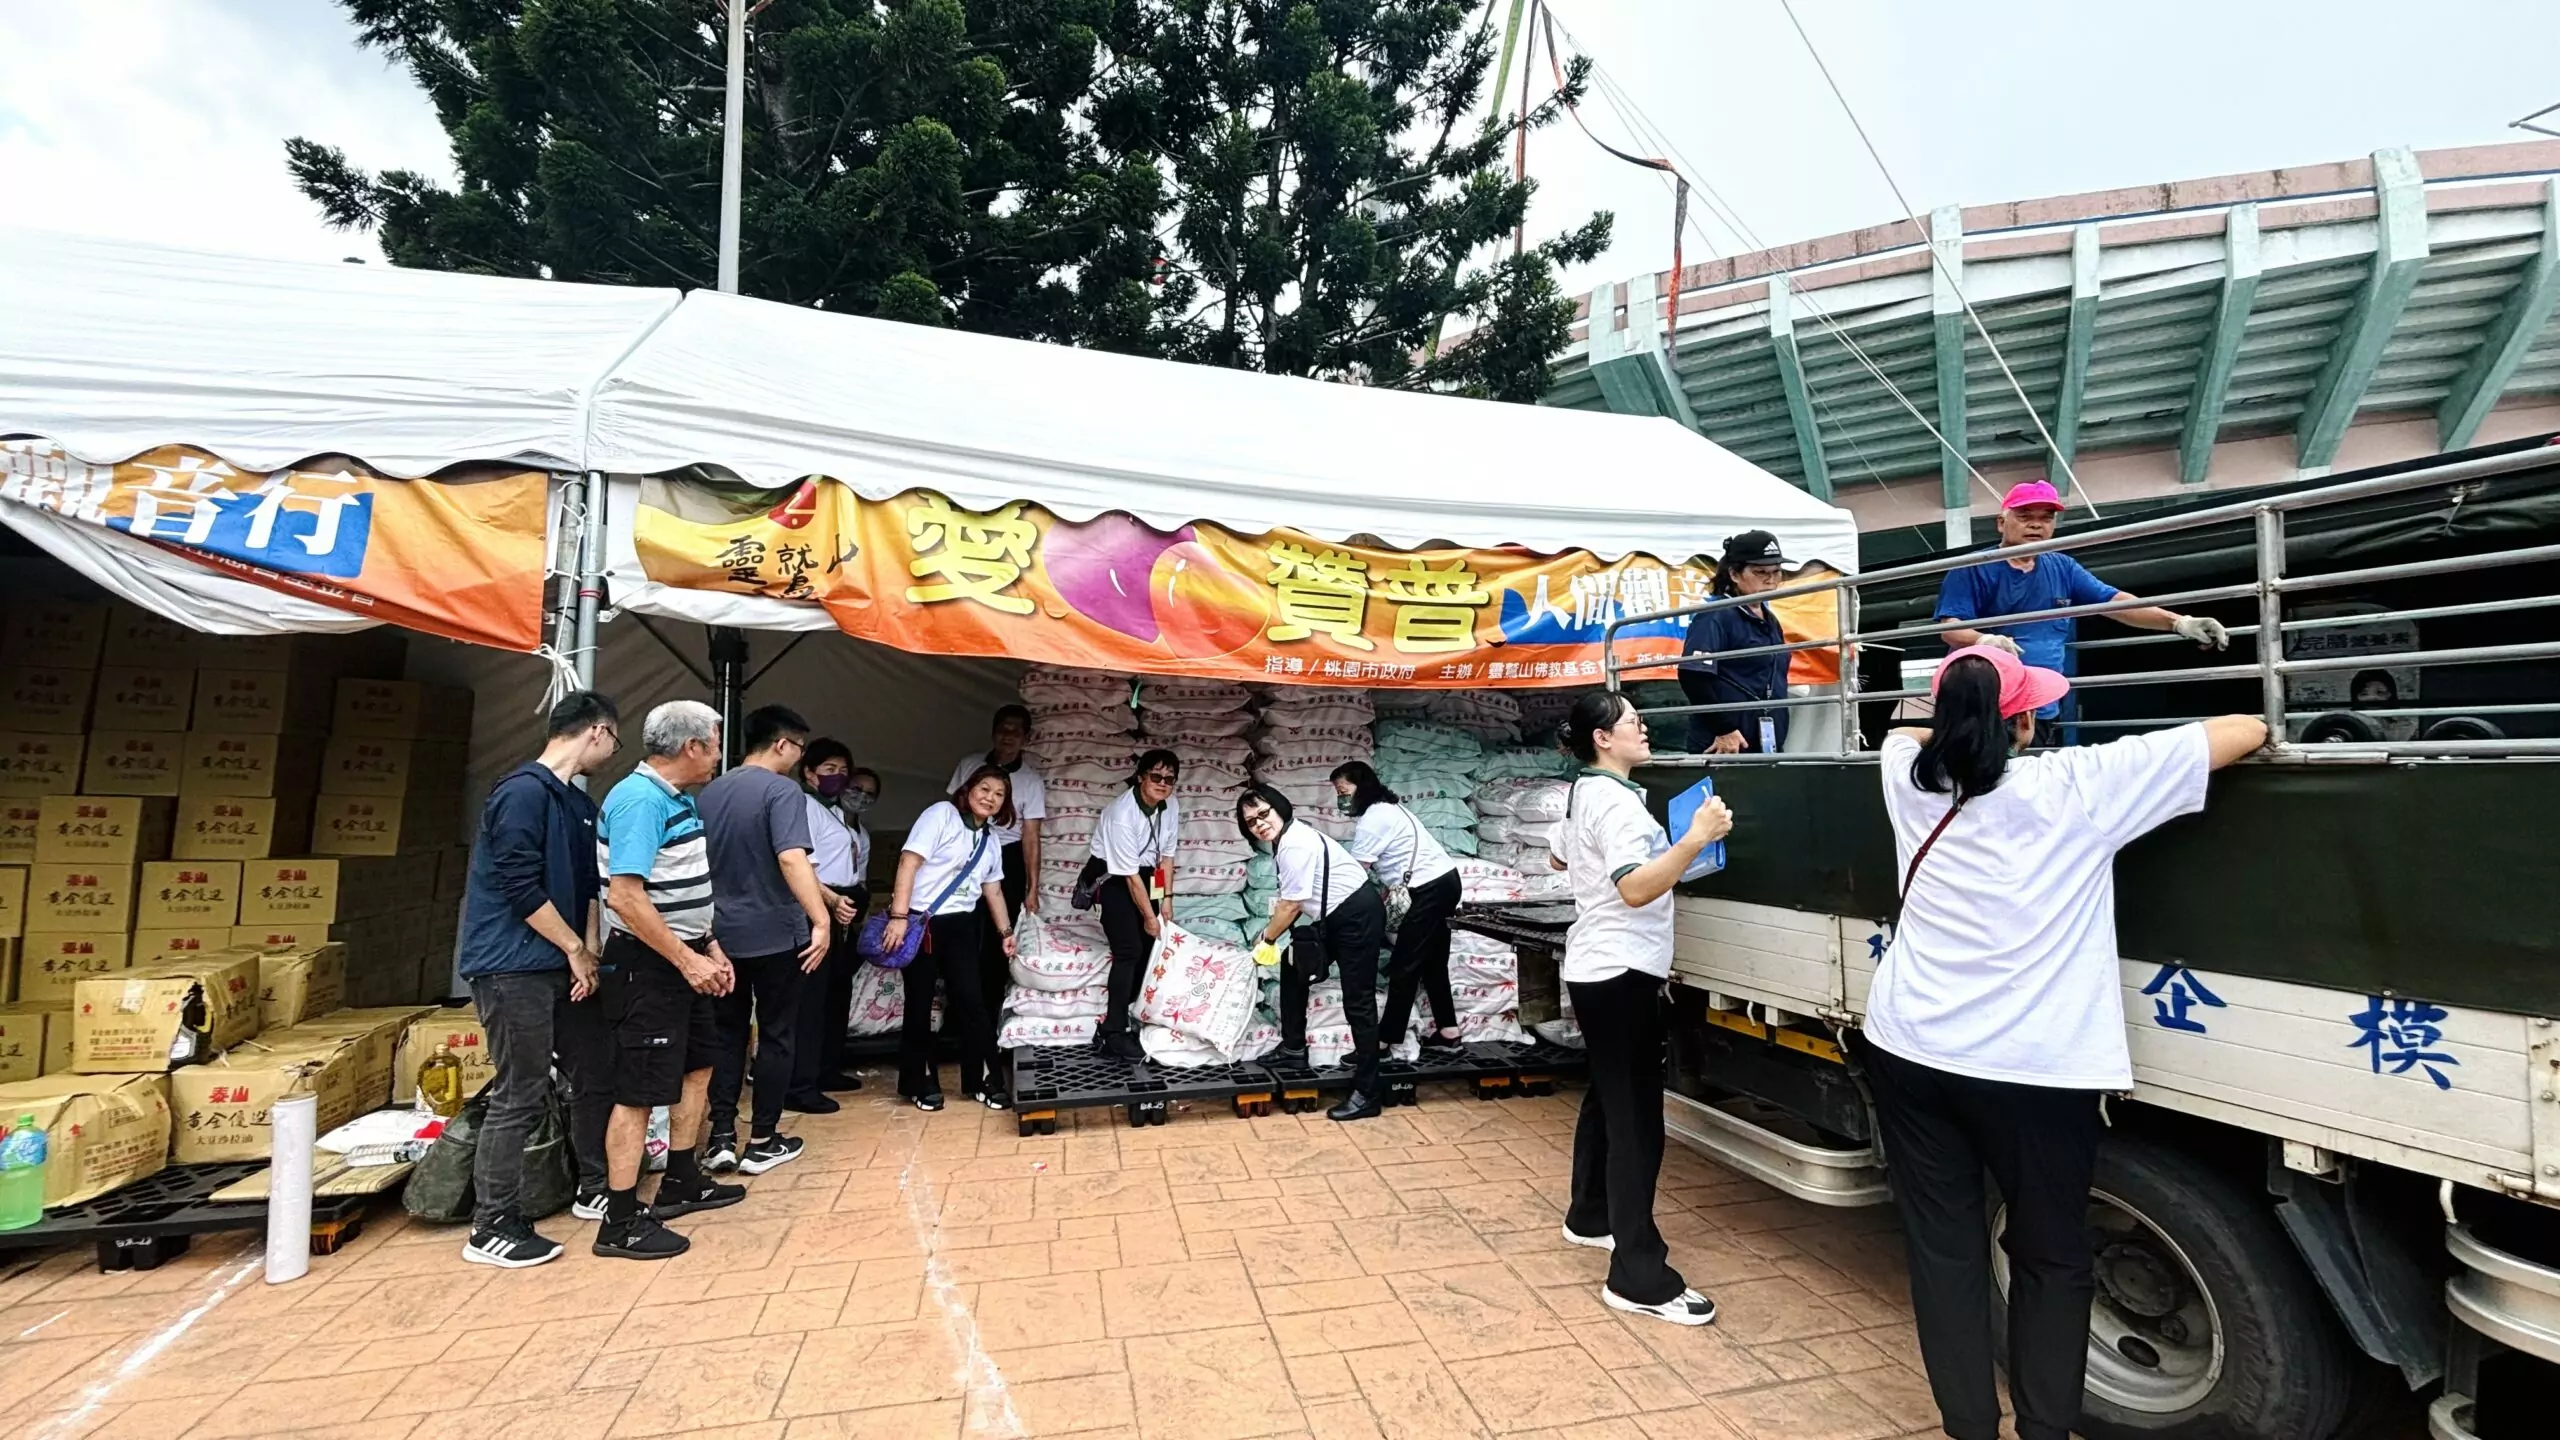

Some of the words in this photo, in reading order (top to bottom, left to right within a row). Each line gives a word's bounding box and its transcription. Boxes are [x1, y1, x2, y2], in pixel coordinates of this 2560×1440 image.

[906, 490, 1038, 615] 愛
[2141, 964, 2227, 1034] 企
[2346, 995, 2461, 1090] 模
[208, 1085, 249, 1104] 泰山
[183, 1109, 274, 1132] 黃金優選
[194, 1134, 254, 1146] 大豆沙拉油
